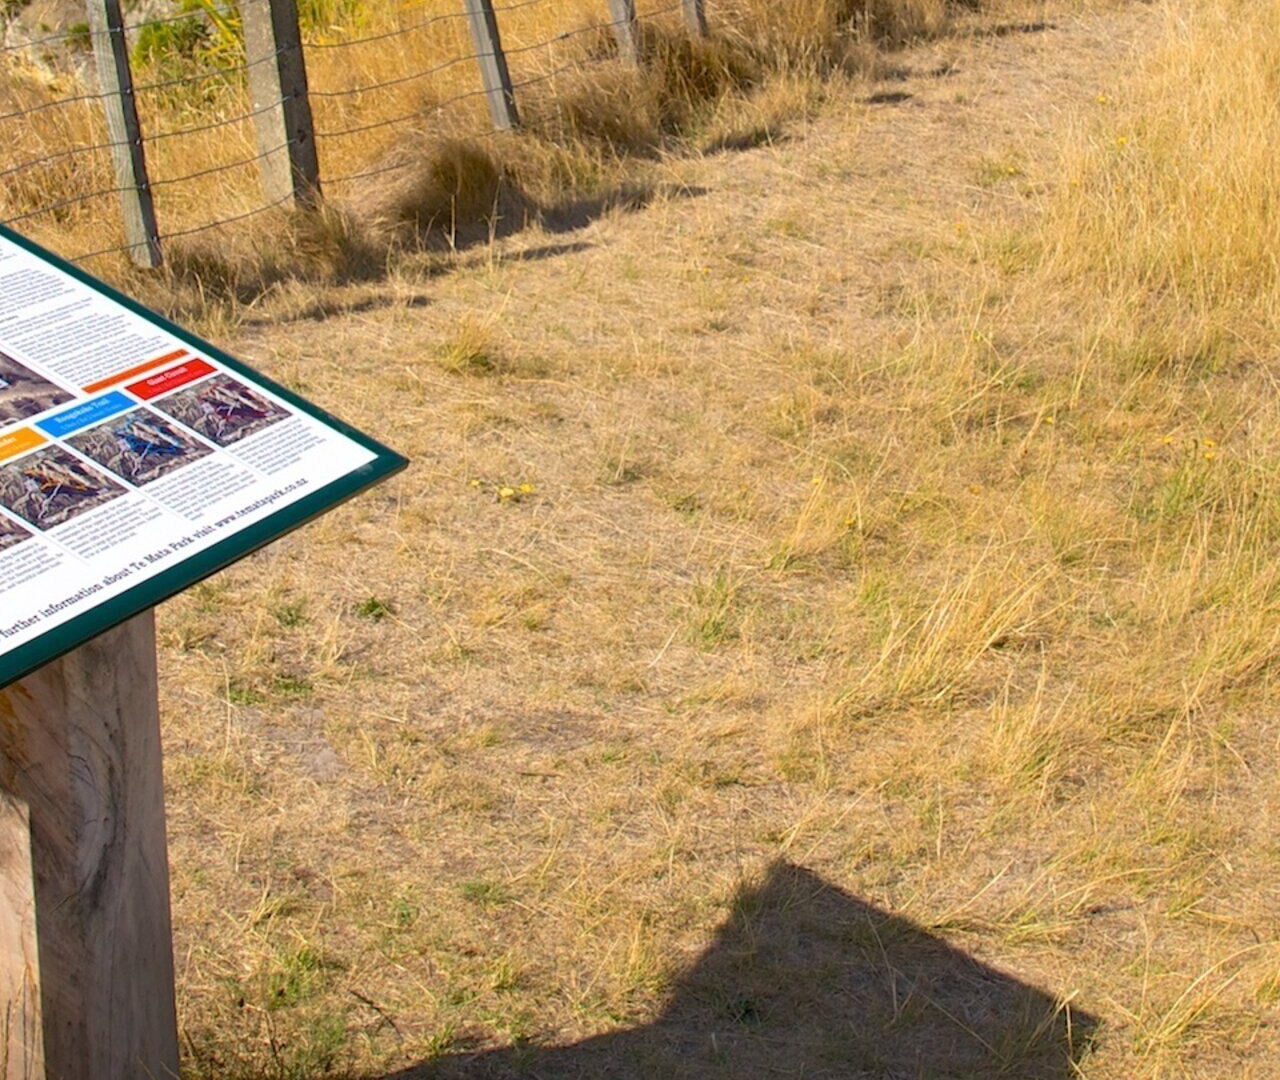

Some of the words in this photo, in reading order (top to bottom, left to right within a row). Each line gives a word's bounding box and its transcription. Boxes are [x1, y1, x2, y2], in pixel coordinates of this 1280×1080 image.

[38, 583, 103, 616] information
[100, 568, 131, 584] about
[129, 560, 147, 570] Te
[144, 548, 171, 562] Mata
[168, 536, 194, 549] Park
[191, 525, 216, 538] visit
[213, 478, 310, 528] www.tematapark.co.nz
